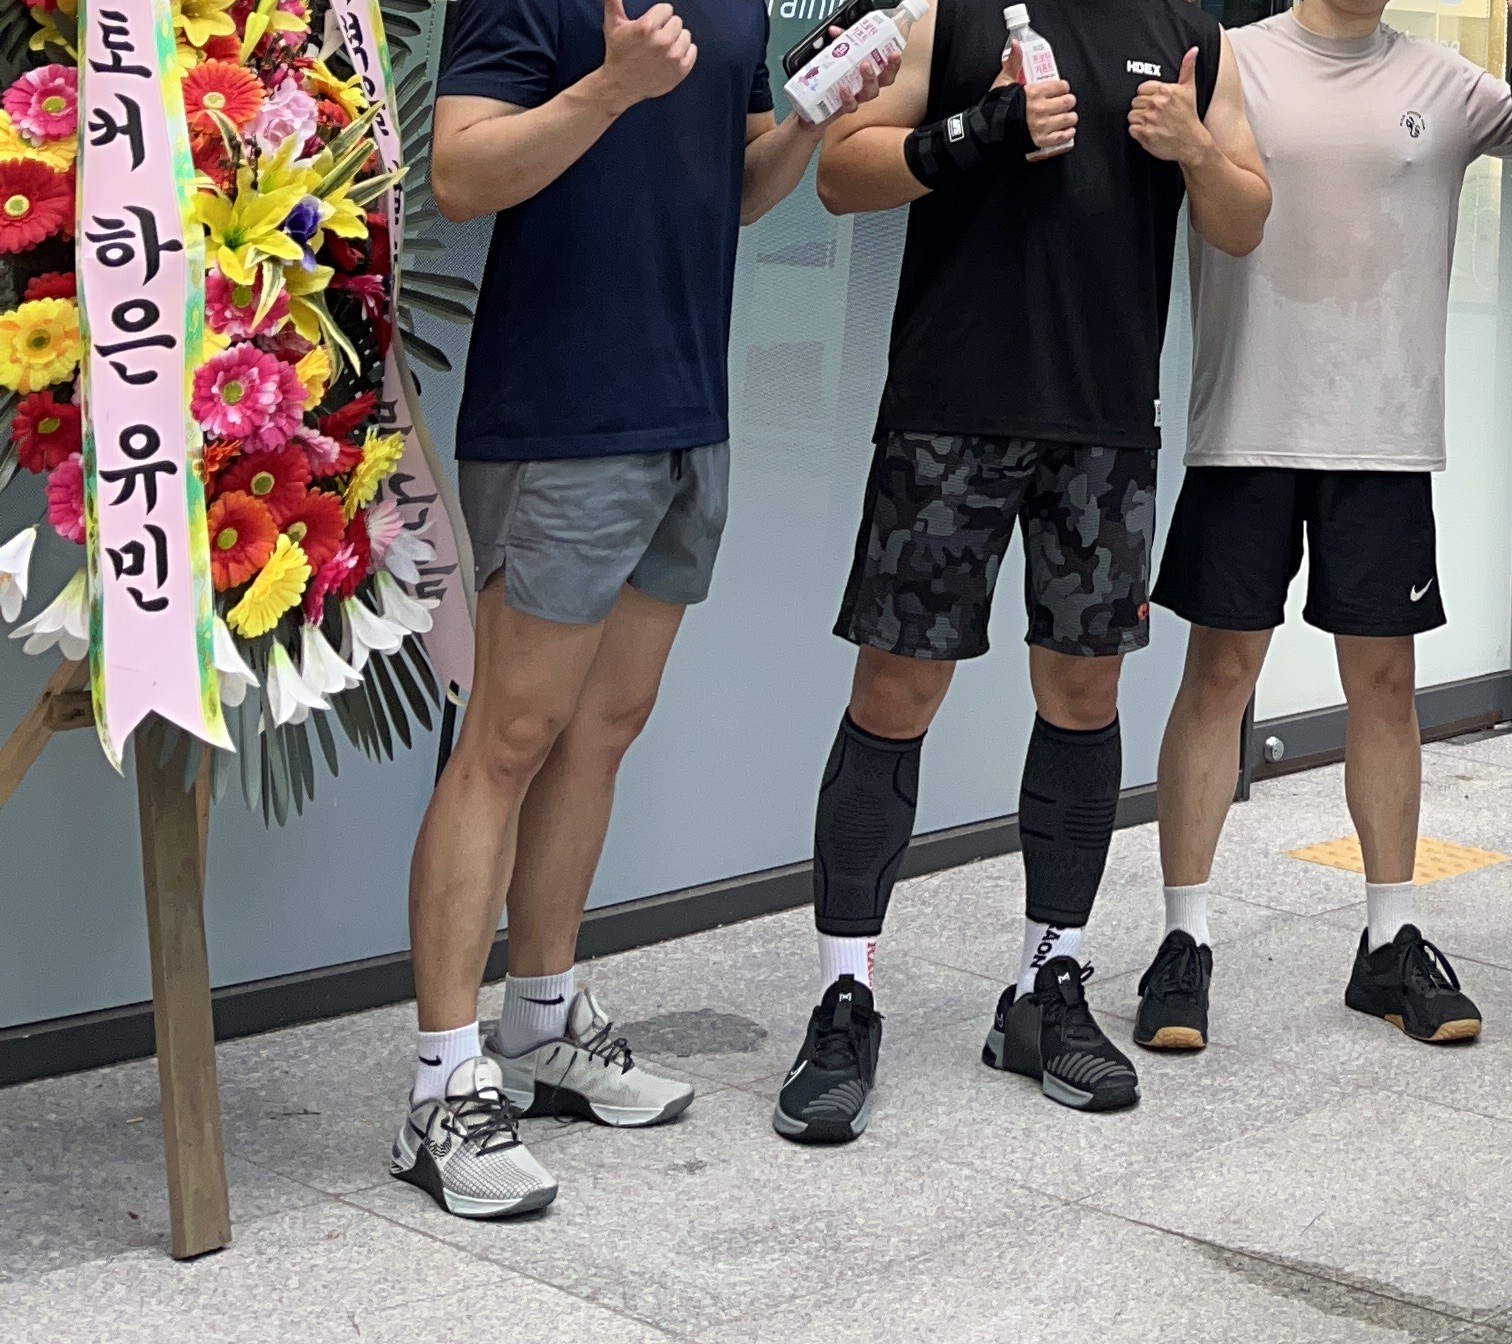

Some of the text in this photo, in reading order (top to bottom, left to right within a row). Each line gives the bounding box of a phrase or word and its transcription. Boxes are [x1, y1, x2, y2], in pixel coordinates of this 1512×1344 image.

[1126, 59, 1162, 77] HDEX
[84, 204, 184, 386] 하은
[97, 422, 178, 614] 유민
